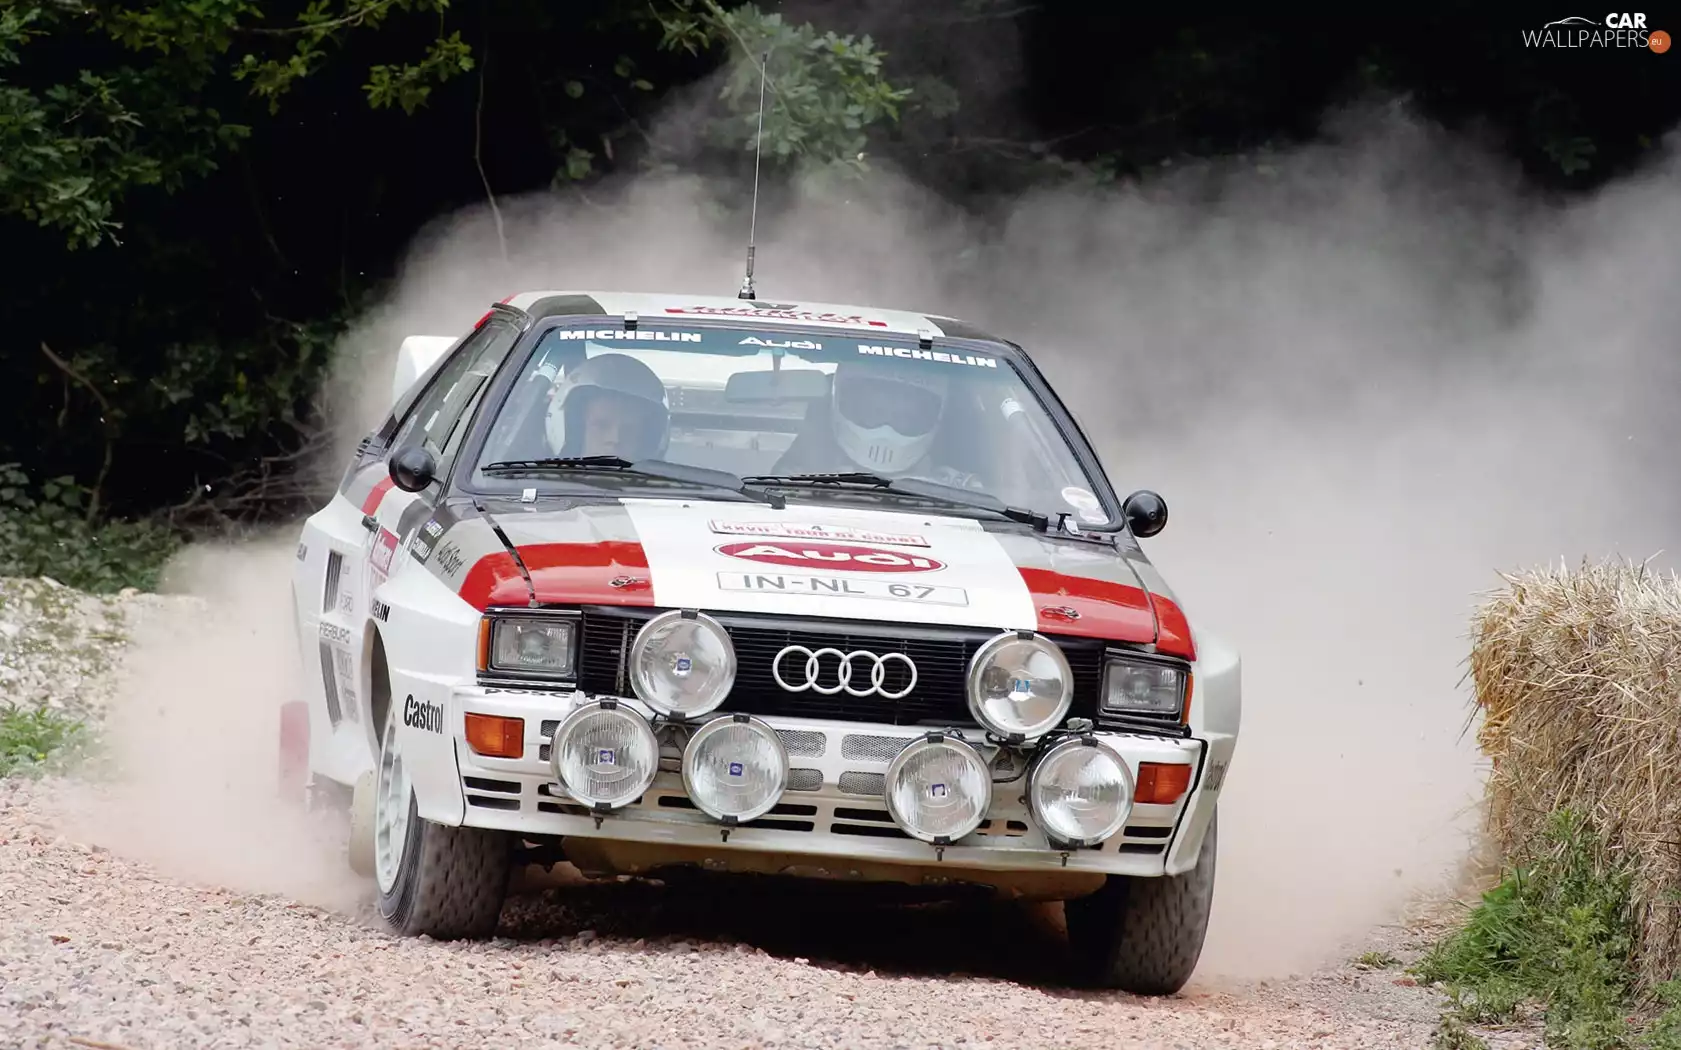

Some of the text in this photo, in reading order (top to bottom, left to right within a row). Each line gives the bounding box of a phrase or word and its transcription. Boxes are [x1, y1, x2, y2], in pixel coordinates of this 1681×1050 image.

[559, 330, 997, 367] MICHELIN Audi MICHELIN
[733, 545, 931, 568] Audi
[742, 574, 936, 600] IN-NL 67
[403, 694, 444, 735] Castrol
